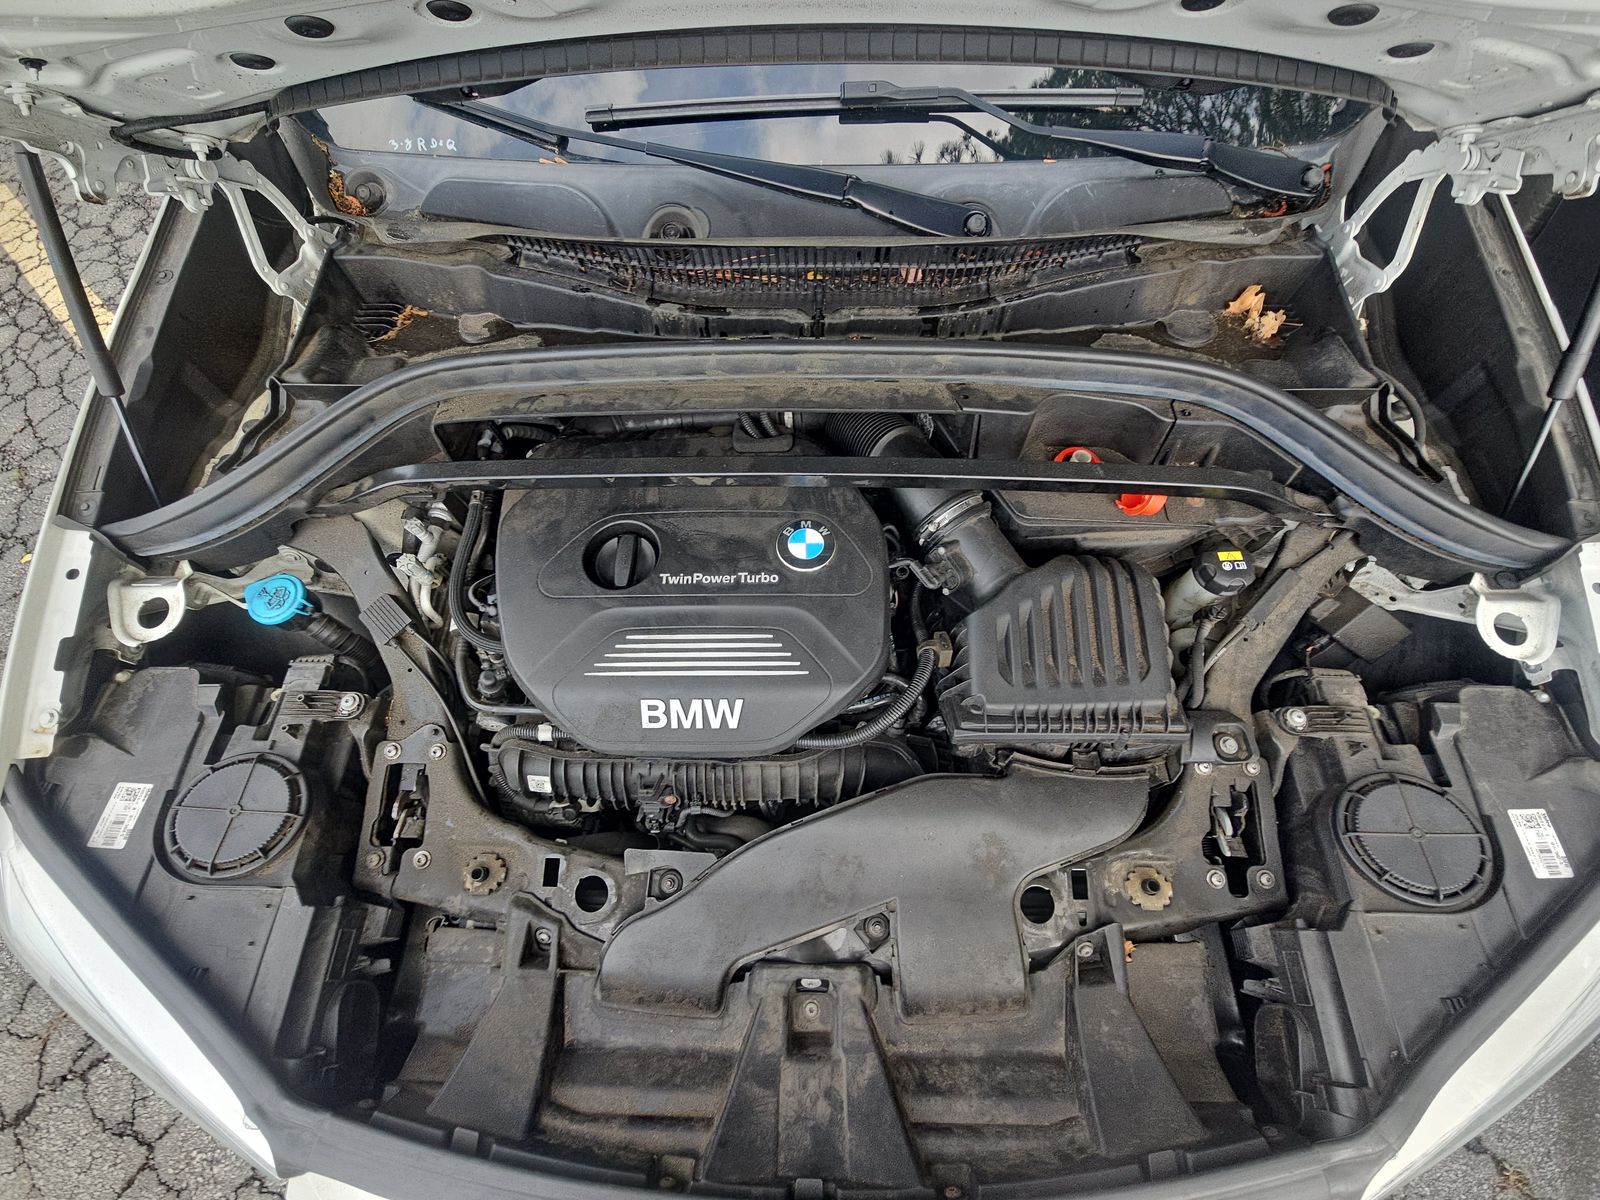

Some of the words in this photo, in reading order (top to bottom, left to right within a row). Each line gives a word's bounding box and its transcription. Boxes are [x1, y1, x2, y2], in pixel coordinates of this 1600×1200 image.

[782, 520, 831, 537] BMW
[659, 572, 737, 585] TwinPower
[738, 571, 779, 584] Turbo
[639, 698, 744, 730] BMW
